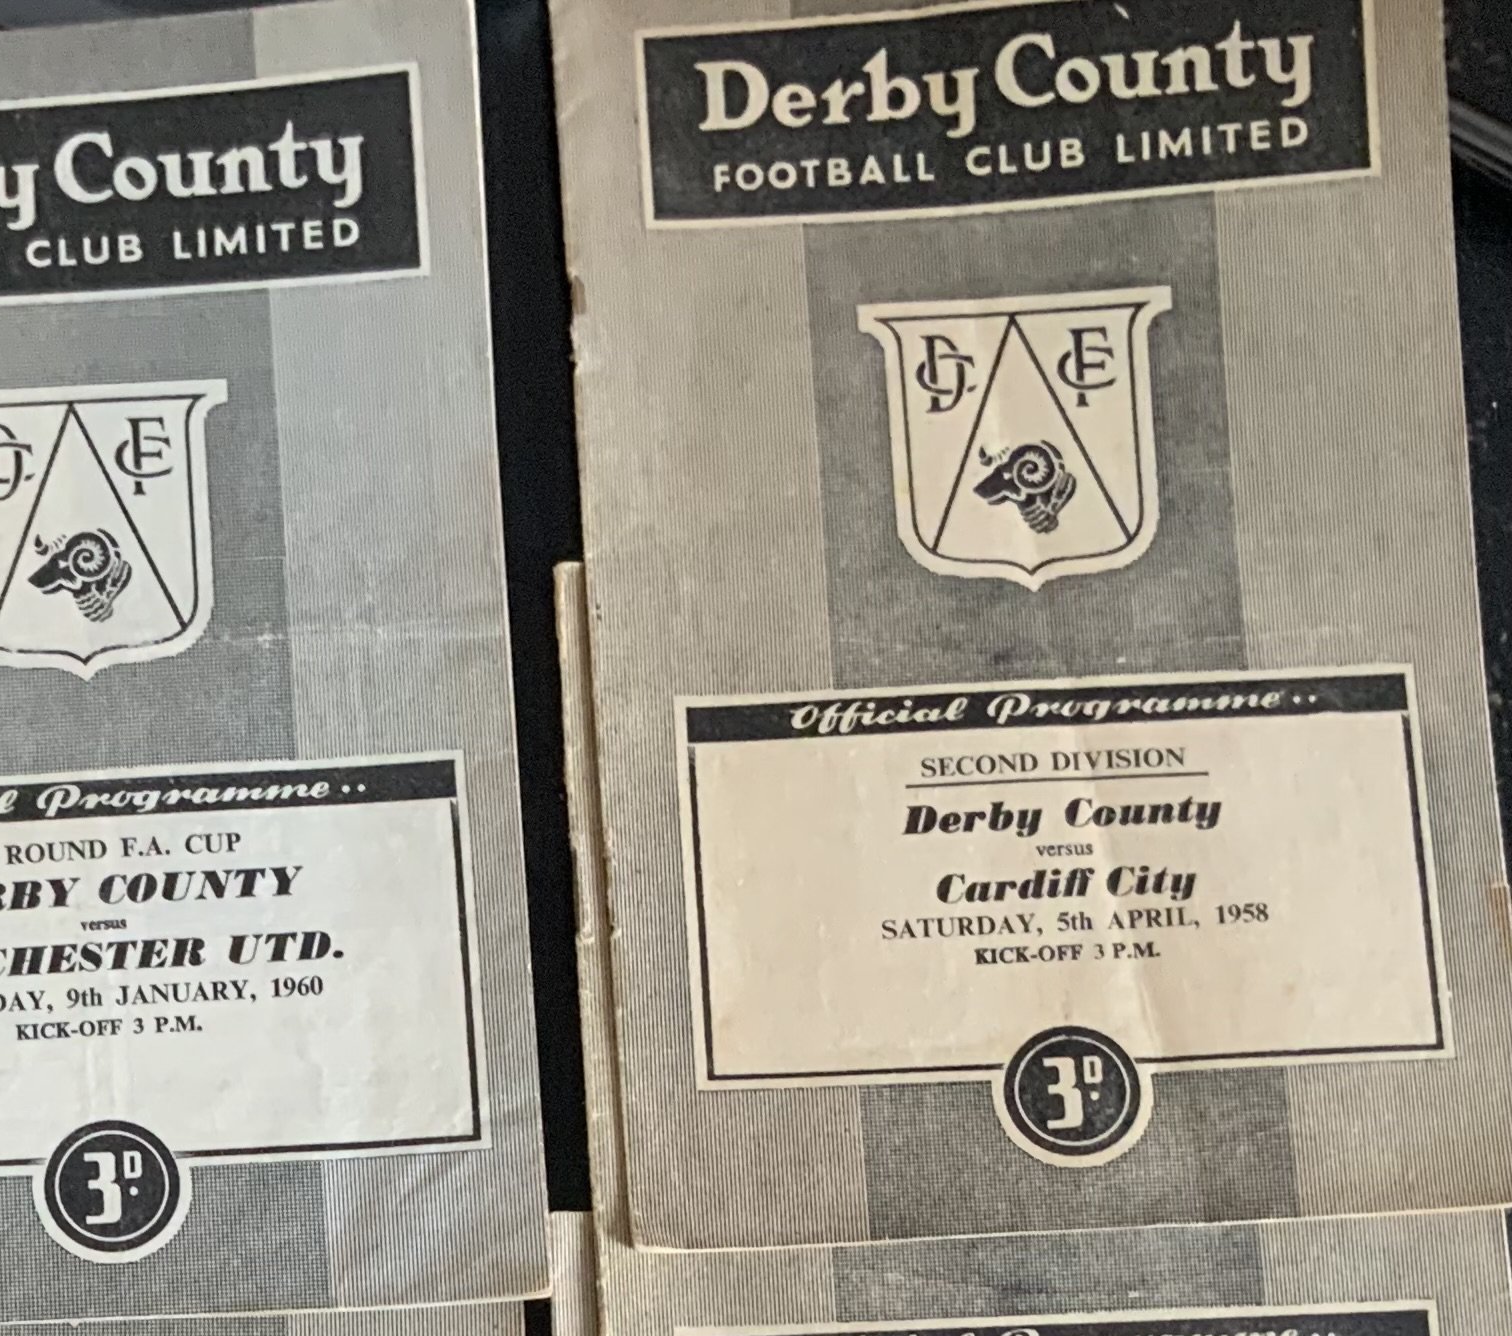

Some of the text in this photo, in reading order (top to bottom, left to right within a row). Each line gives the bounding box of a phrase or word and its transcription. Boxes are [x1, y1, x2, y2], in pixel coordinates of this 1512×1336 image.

[694, 19, 1314, 139] Derby County
[53, 120, 364, 208] County
[713, 116, 1309, 193] FOOTBALL CLUB LIMITED
[25, 233, 143, 268] CLUB
[172, 217, 360, 260] LIMITED
[920, 747, 1184, 778] SECOND DIVISION
[903, 796, 1222, 838] Derby County
[4, 839, 108, 865] ROUND
[120, 835, 171, 858] F.A.
[184, 832, 242, 855] CUP
[1035, 843, 1094, 857] versus
[98, 865, 303, 905] COUNTY
[936, 865, 1197, 904] Cardiff City
[80, 918, 128, 932] versus
[881, 902, 1269, 940] SATURDAY, 5th APRIL, 1958
[228, 931, 344, 965] UTD.
[974, 941, 1161, 965] KICK-OFF 3 P.M.
[66, 987, 103, 1009] 9th
[115, 979, 257, 1006] JANUARY,
[271, 975, 324, 998] 1960
[15, 1015, 203, 1041] KICK-OFF 3 P.M.
